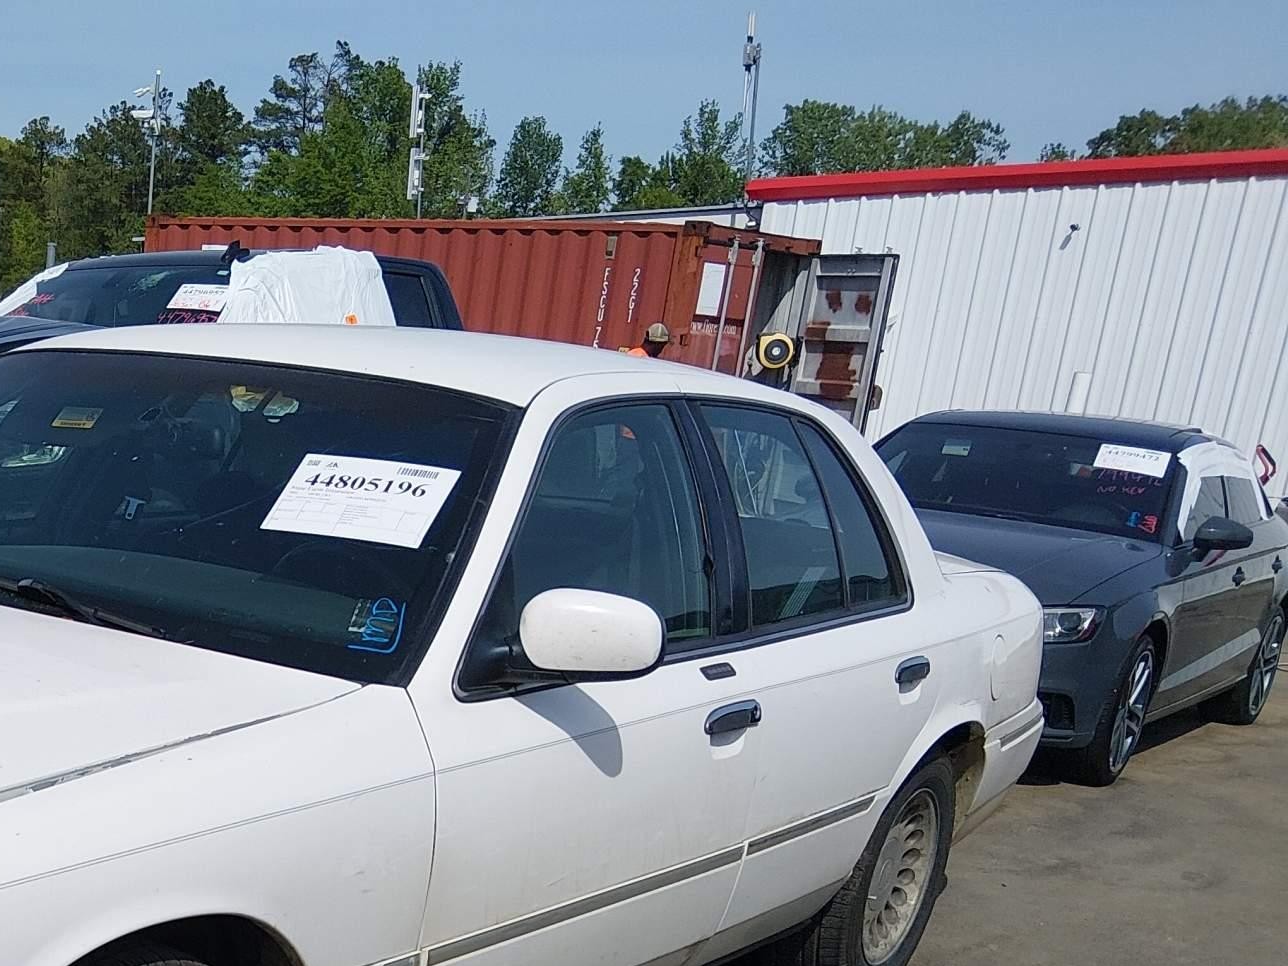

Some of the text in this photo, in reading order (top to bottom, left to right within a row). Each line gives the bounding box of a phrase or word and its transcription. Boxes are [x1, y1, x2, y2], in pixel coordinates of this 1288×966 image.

[597, 267, 612, 322] FSCU
[627, 268, 641, 323] 22G1
[305, 472, 434, 499] 44805196
